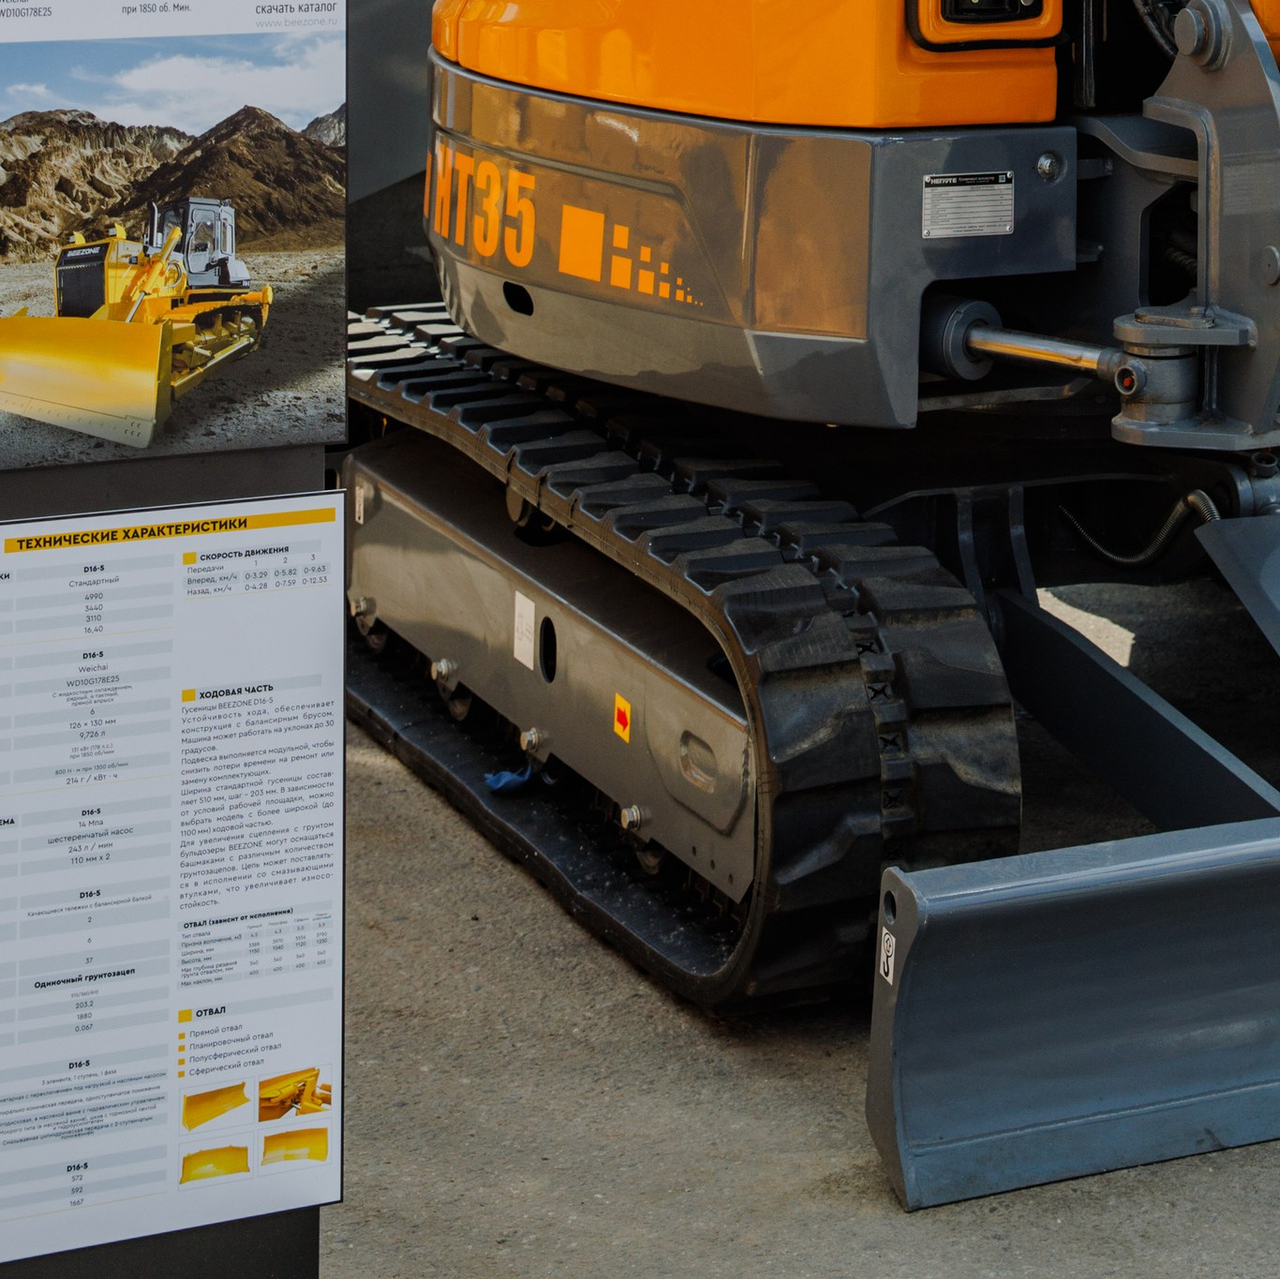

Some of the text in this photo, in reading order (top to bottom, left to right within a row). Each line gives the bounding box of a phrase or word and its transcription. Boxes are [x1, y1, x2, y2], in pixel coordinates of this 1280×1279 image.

[122, 2, 192, 15] при 1850 об. Мин.
[256, 3, 337, 14] скачать каталог
[256, 18, 337, 27] www.beezone.ru
[434, 141, 536, 268] HT35
[17, 518, 247, 550] ТЕХНИЧЕСКИЕ ХАРАКТЕРИСТИКИ
[200, 546, 289, 561] СКОРОСТЬ ДВИЖЕНИЯ
[199, 684, 274, 699] ХОДОВАЯ ЧАСТЬ
[183, 920, 207, 929] ОТВАЛ
[208, 916, 239, 926] (зависит
[249, 907, 294, 919] исполнения)
[196, 1006, 226, 1018] ОТВАЛ
